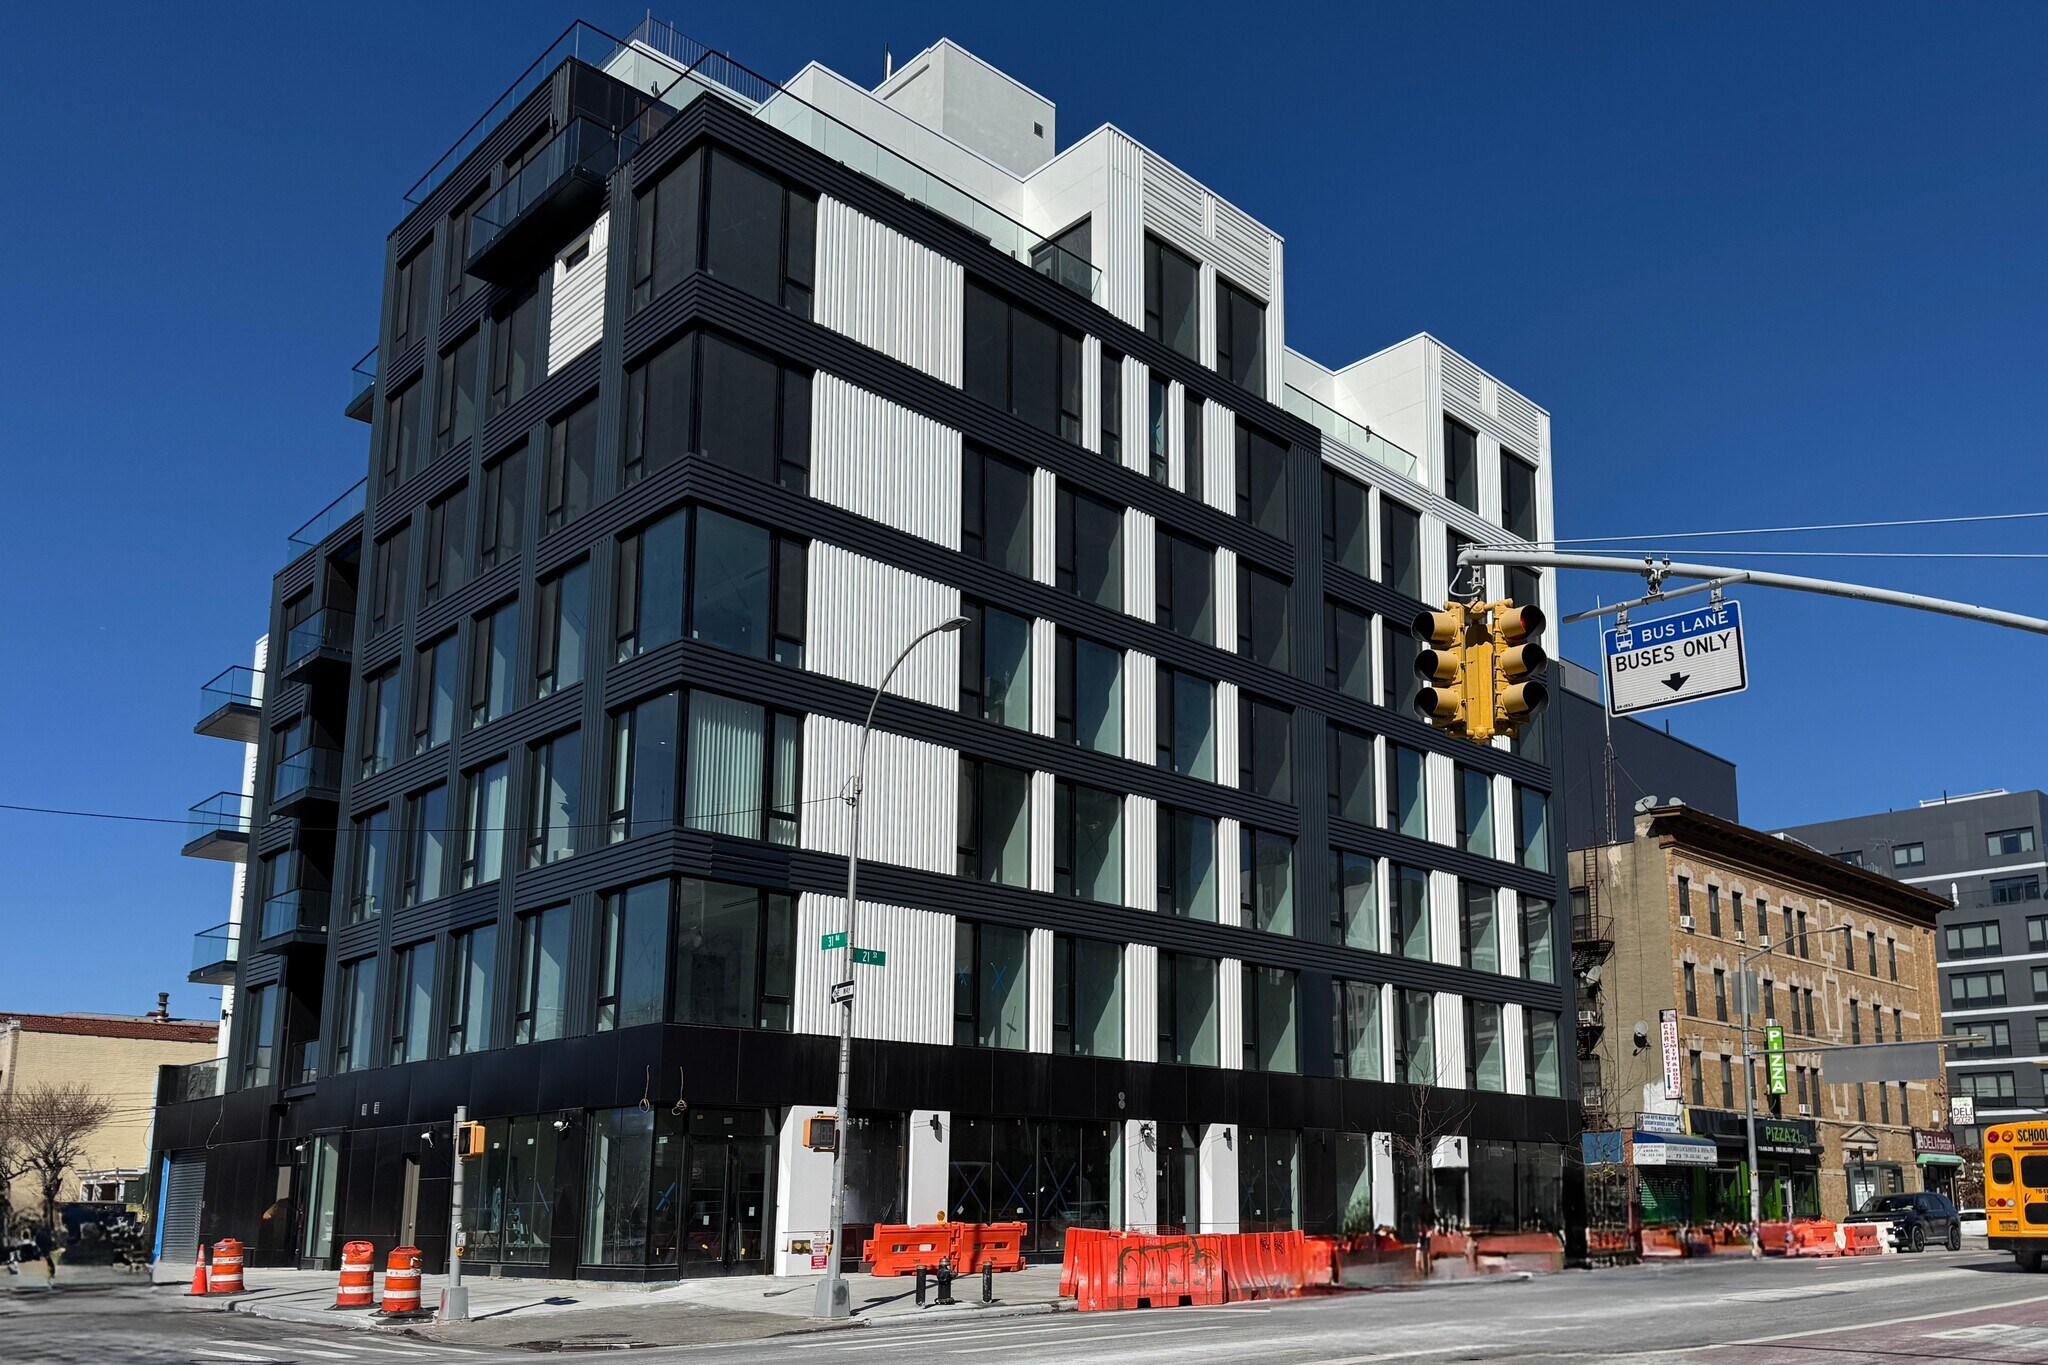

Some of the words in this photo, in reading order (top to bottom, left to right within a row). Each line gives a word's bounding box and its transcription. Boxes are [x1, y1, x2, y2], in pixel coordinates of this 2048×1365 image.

[1641, 623, 1675, 642] BUS
[1681, 611, 1729, 633] LANE
[1616, 645, 1675, 673] BUSES
[1683, 631, 1731, 657] ONLY
[828, 935, 834, 947] 31
[862, 951, 870, 963] 21
[1769, 1030, 1786, 1092] PIZZA
[1953, 1107, 1973, 1116] DELI
[1765, 1126, 1791, 1142] PIZZA
[2018, 1128, 2048, 1142] SCHOOL
[1923, 1135, 1937, 1149] DELI
